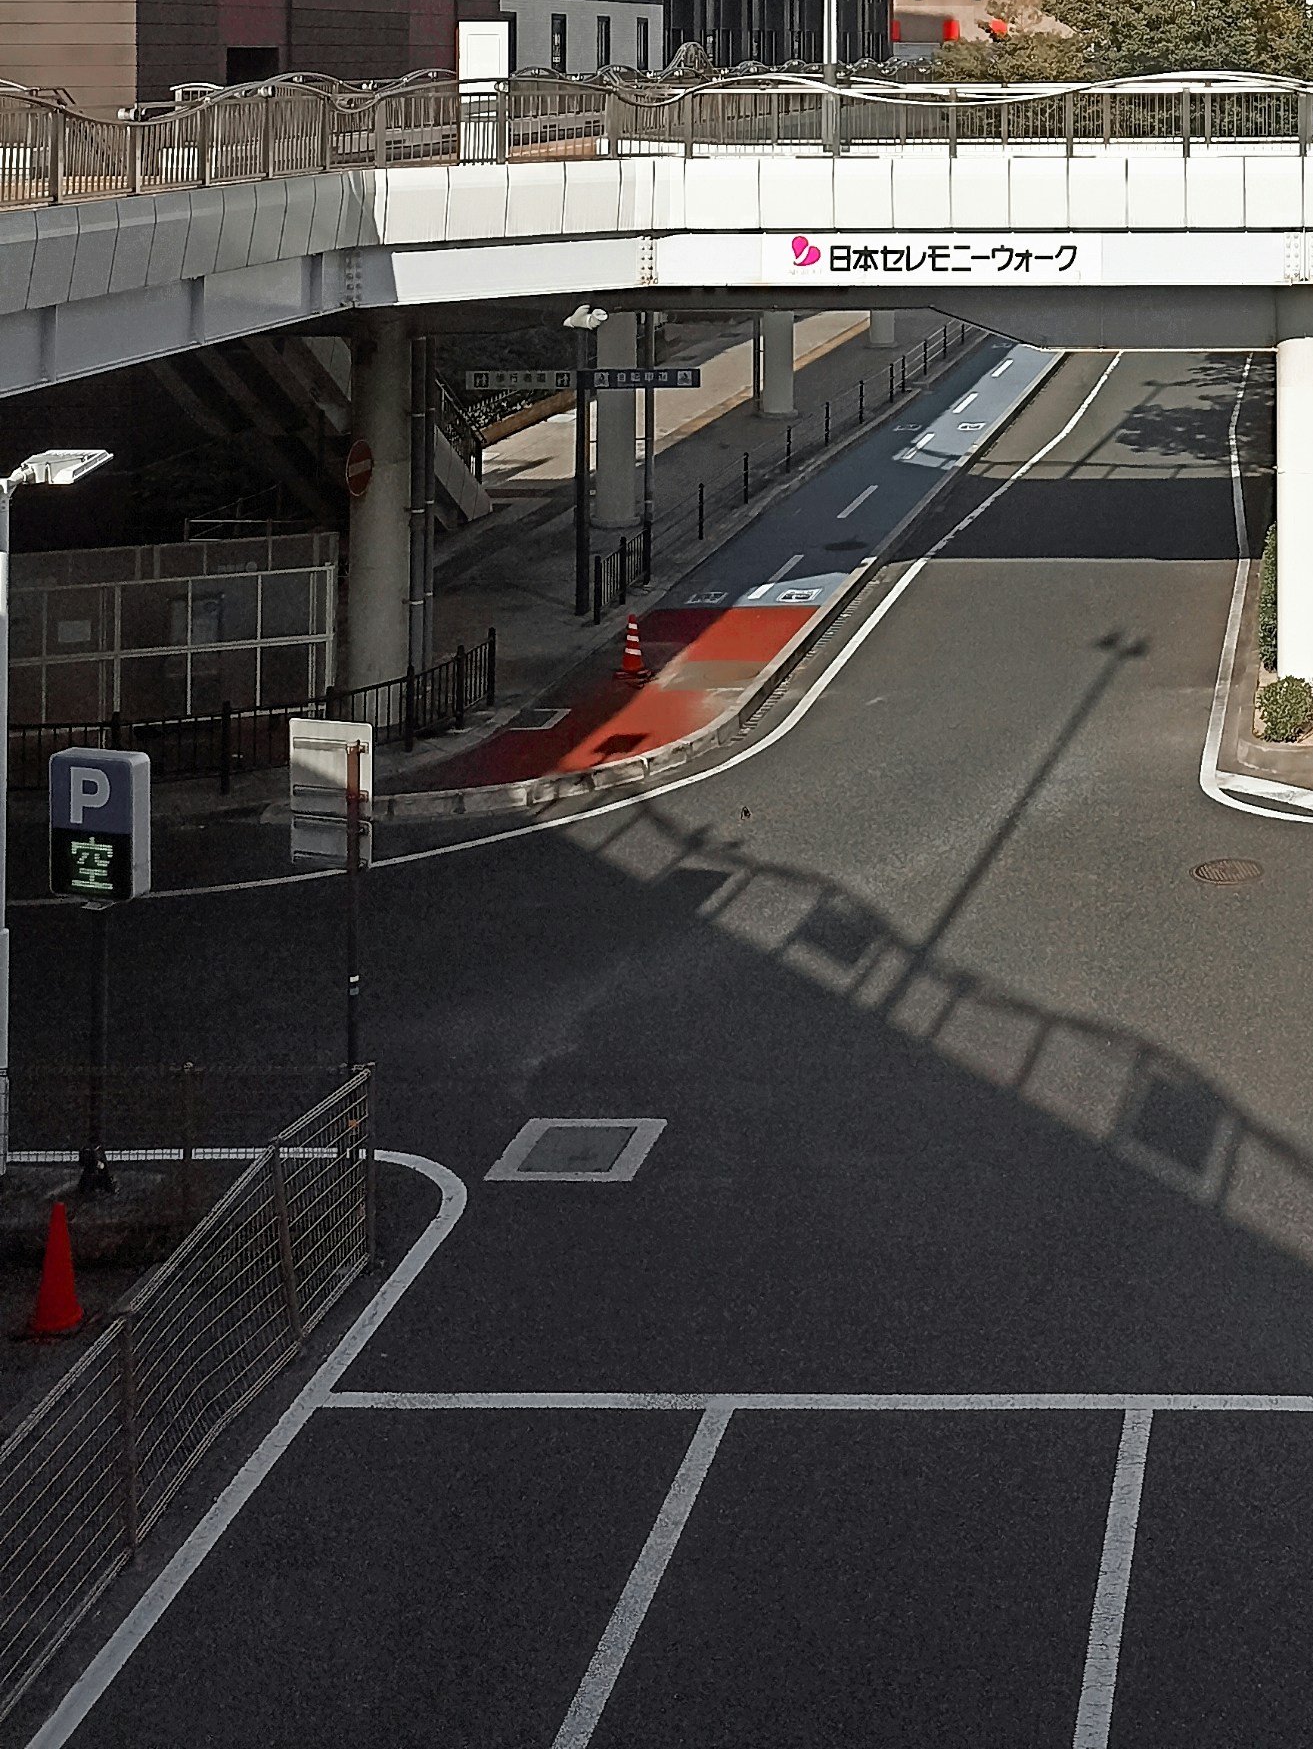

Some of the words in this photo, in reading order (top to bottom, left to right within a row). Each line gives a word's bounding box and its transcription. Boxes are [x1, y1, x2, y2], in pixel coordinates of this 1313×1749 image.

[830, 244, 1078, 272] 日本セレモニーウォーク
[70, 766, 111, 824] P
[70, 836, 114, 891] 空
